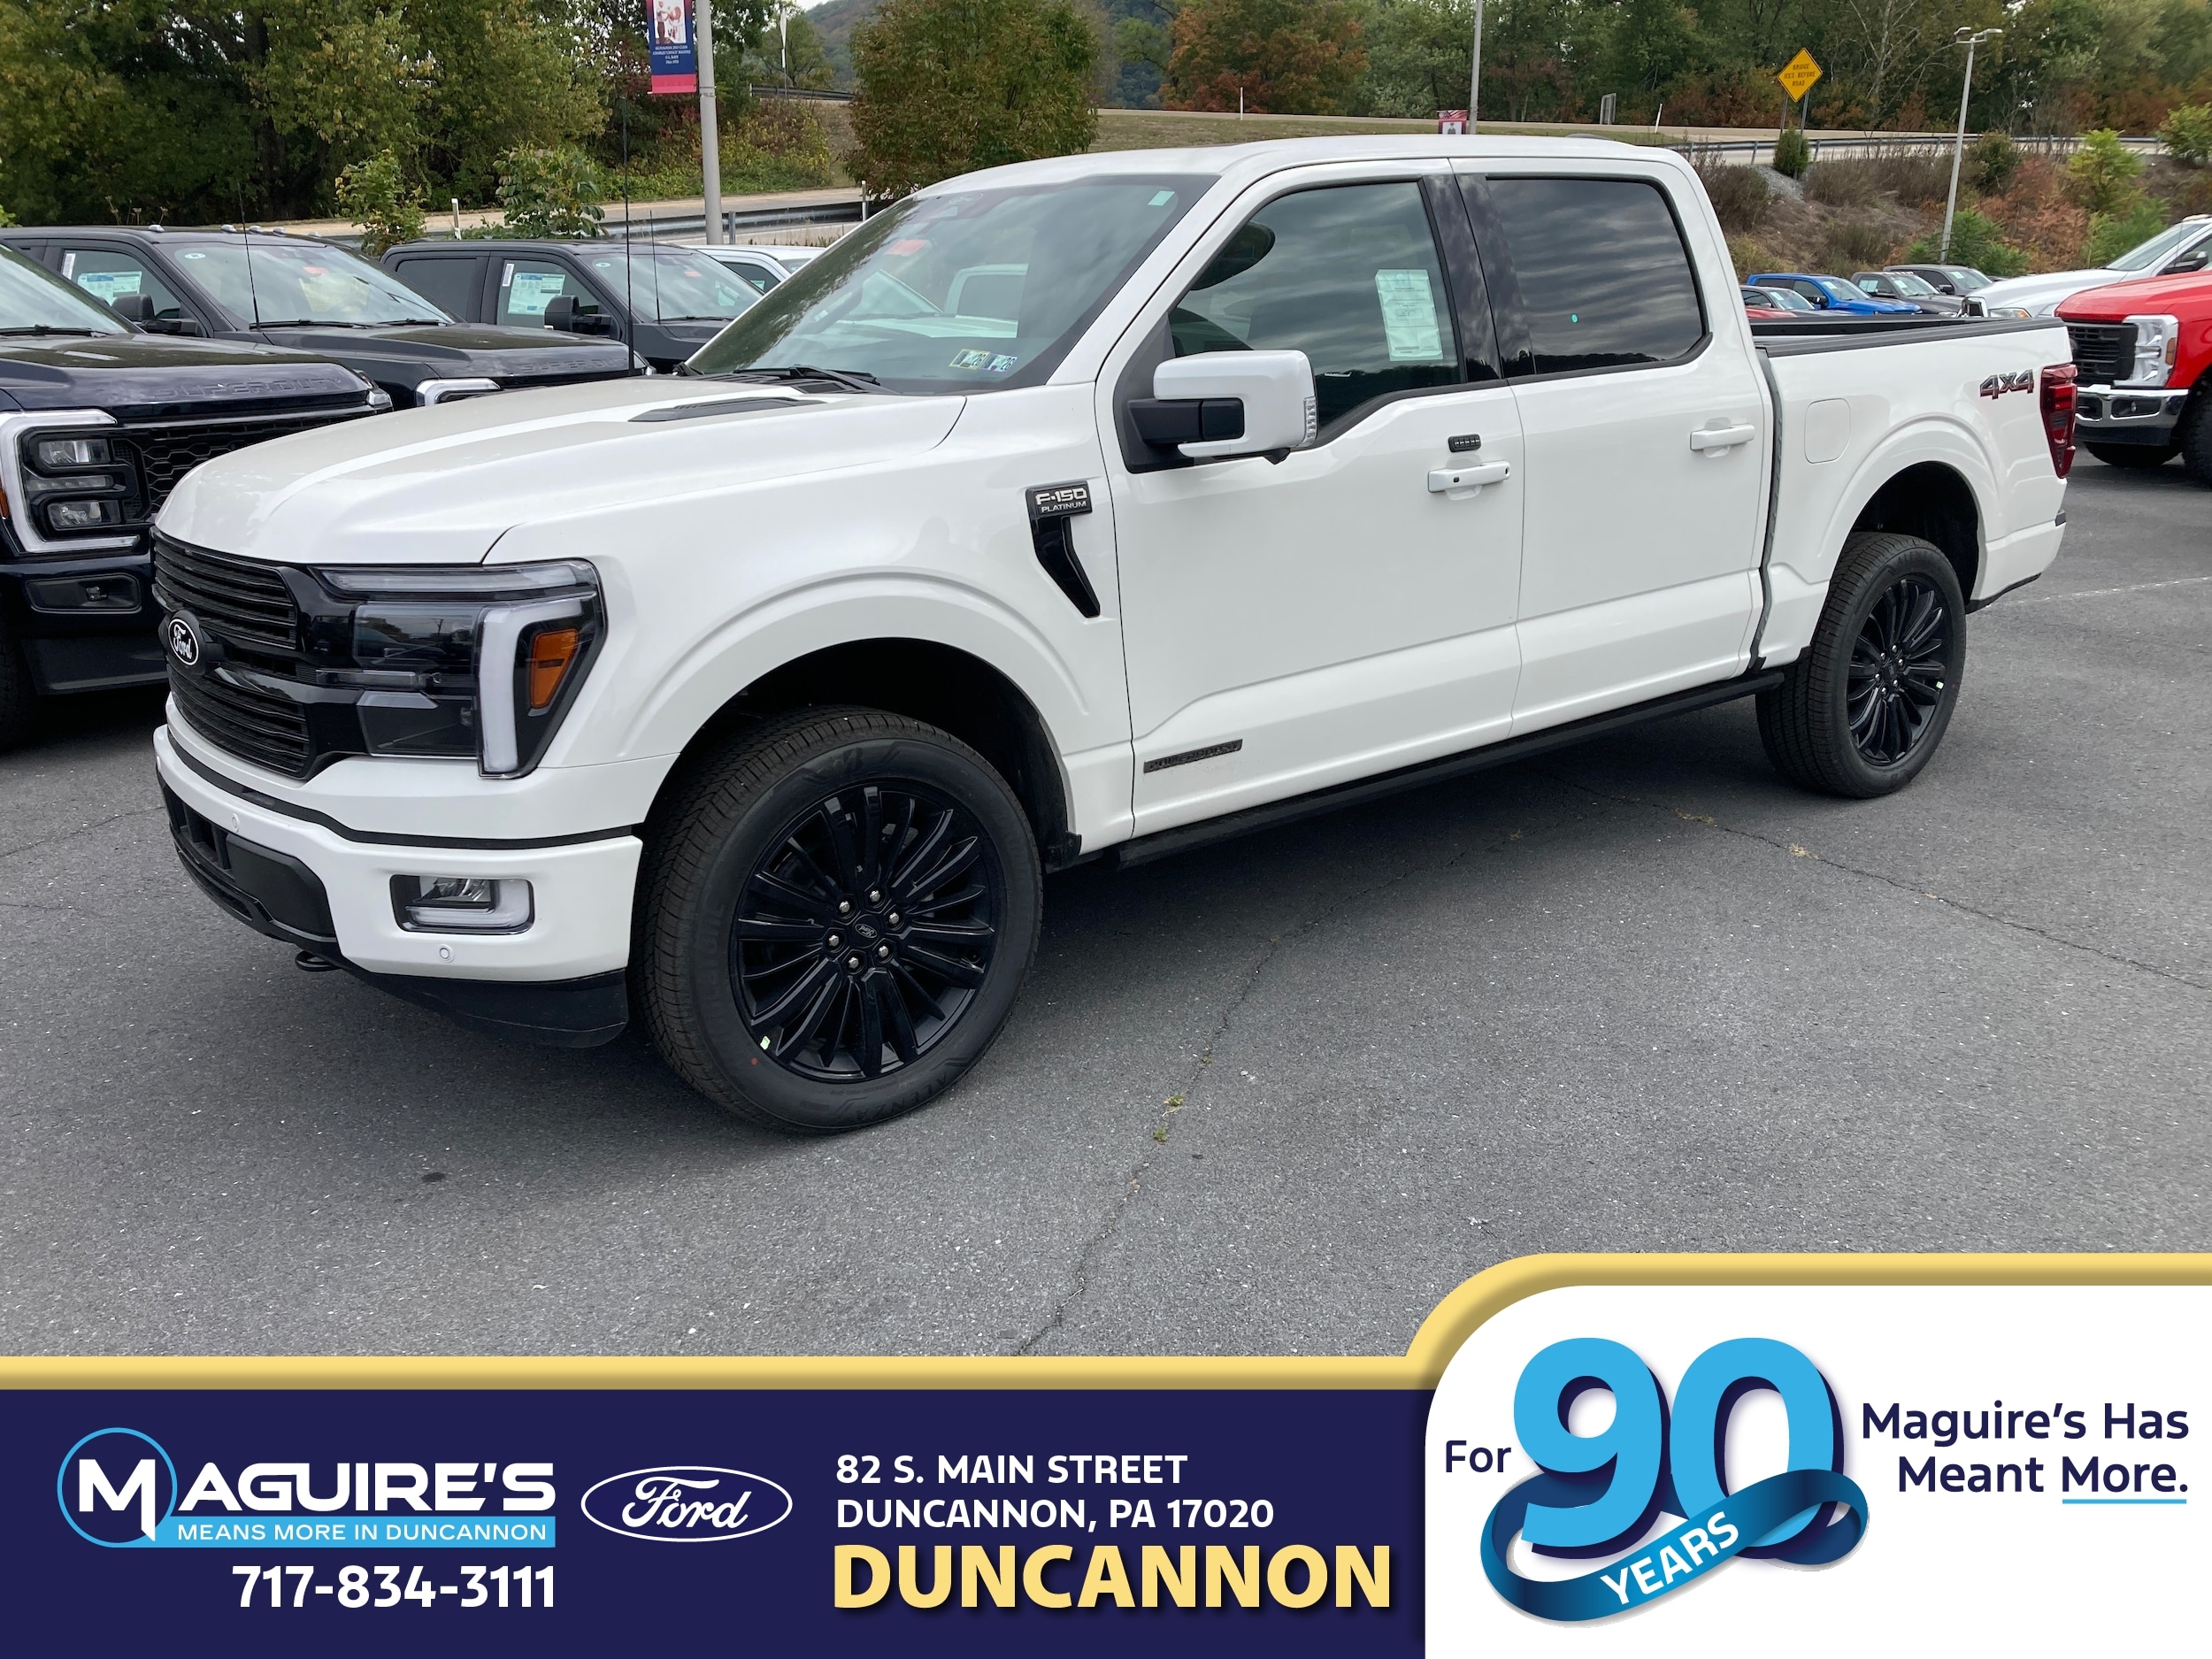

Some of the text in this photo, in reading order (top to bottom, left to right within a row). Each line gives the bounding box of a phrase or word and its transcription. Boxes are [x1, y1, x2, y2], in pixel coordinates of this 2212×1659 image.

[153, 378, 342, 397] SUPER DUTY
[1035, 487, 1087, 505] F-150
[1041, 500, 1087, 513] PLATINUM
[173, 623, 193, 661] Ford
